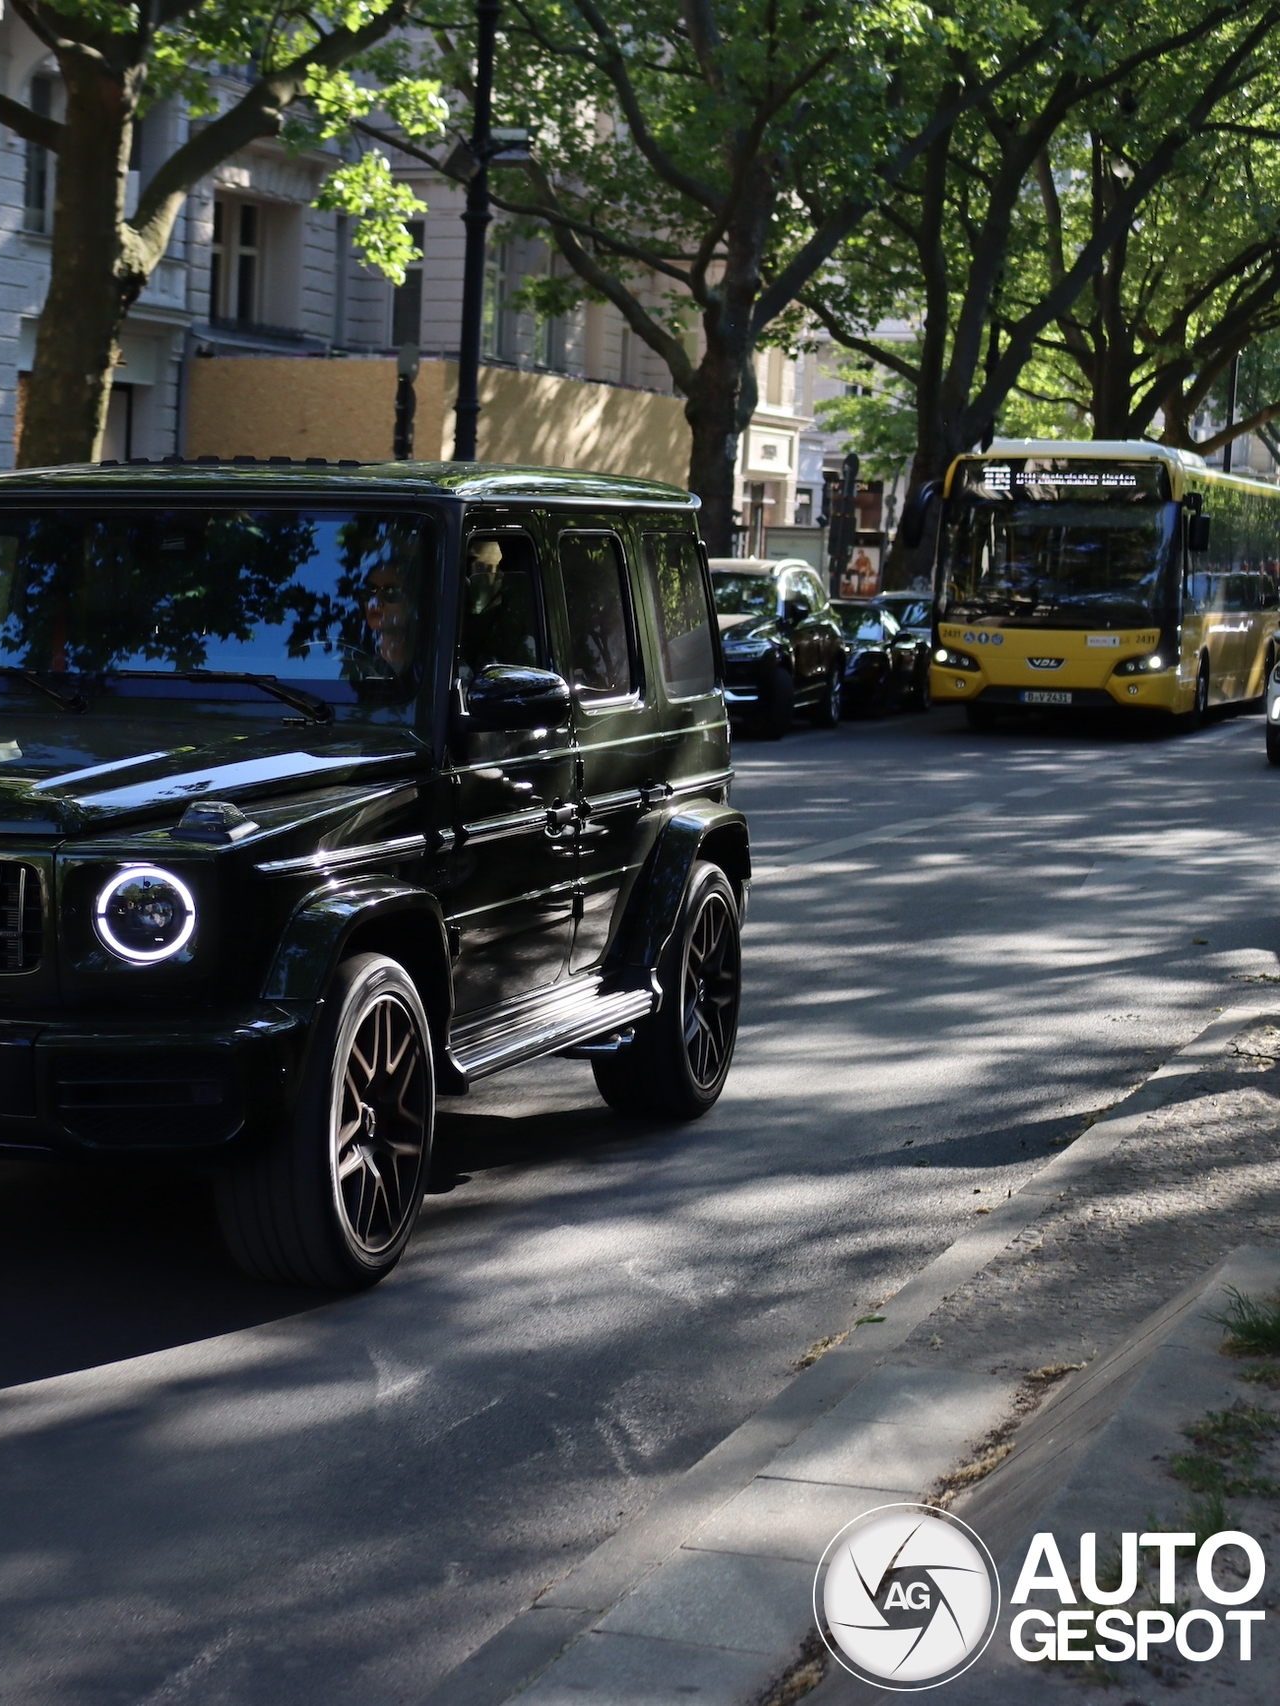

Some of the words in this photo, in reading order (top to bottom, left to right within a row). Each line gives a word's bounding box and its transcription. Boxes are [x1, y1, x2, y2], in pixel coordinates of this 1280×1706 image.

[943, 629, 961, 638] 2431
[1135, 635, 1155, 644] 2431
[1032, 658, 1058, 667] VDL
[1039, 692, 1045, 702] V
[1047, 693, 1068, 703] 2431
